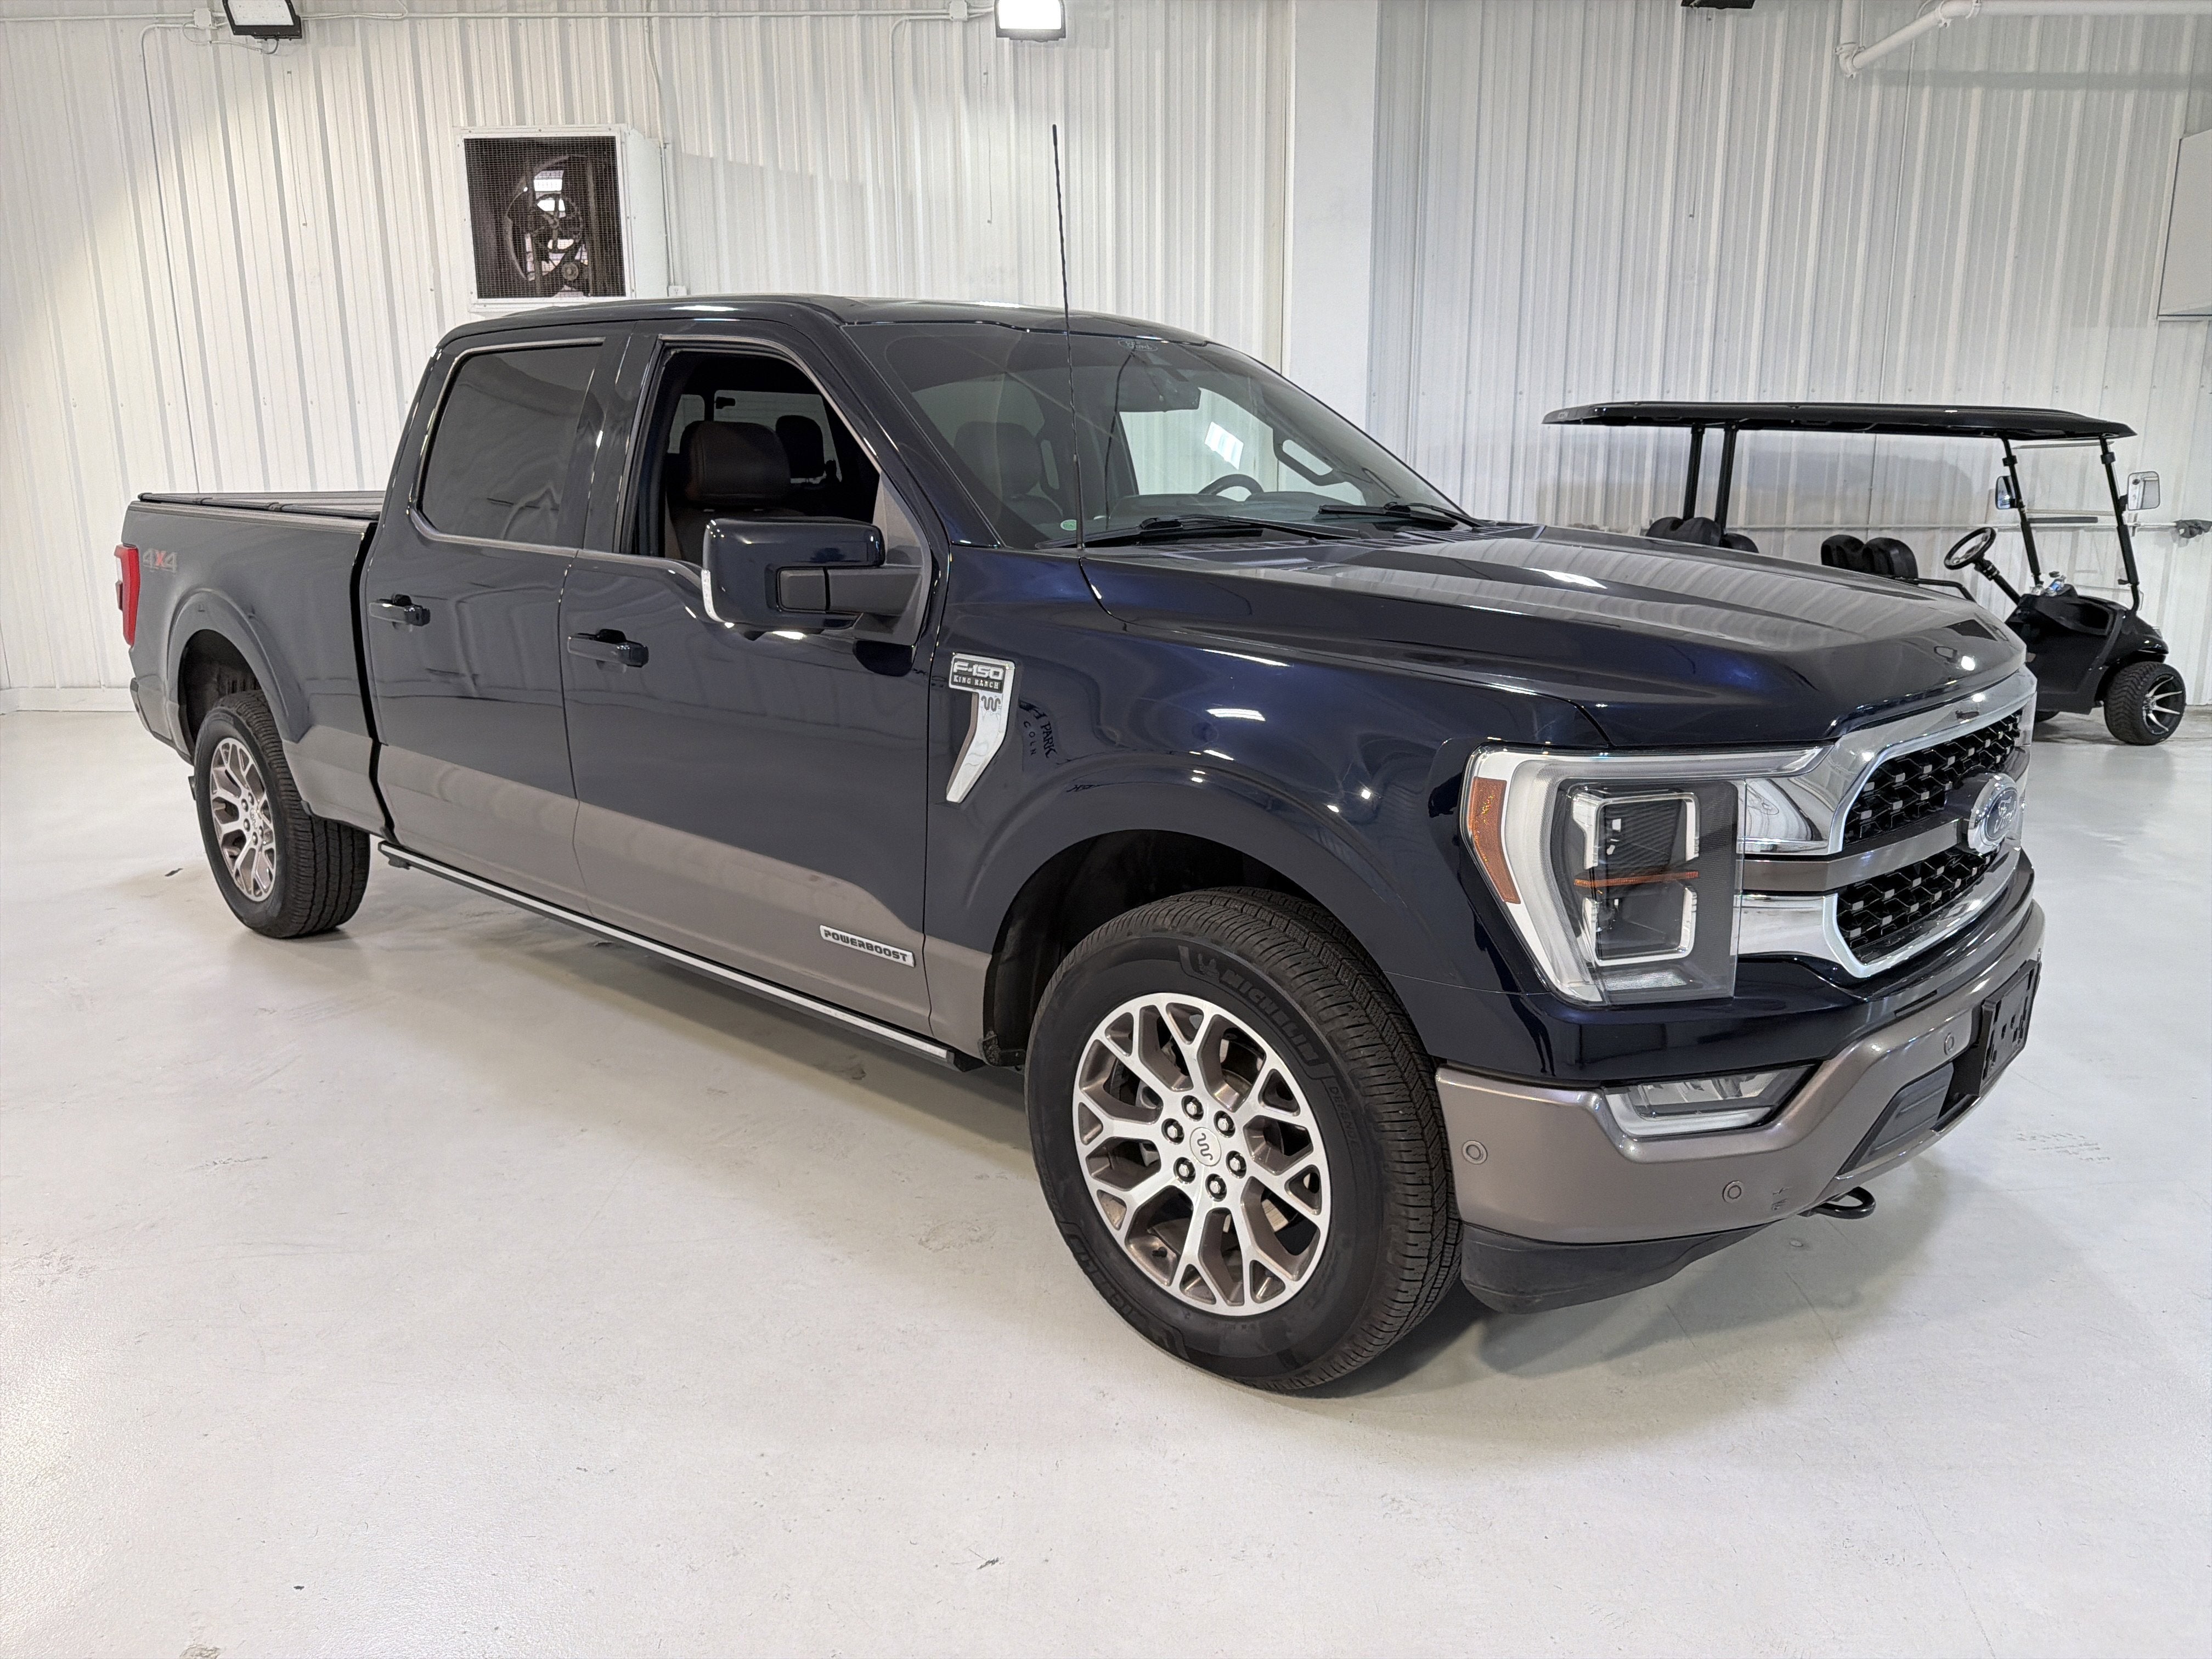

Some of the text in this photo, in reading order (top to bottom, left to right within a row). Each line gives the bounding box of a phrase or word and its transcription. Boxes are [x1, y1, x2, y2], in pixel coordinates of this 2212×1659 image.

[953, 661, 1005, 680] F-150
[953, 675, 998, 690] KING RANCH
[823, 928, 908, 962] POWERBOOST
[1219, 969, 1319, 1062] MICHELIN
[1328, 1086, 1360, 1149] DEFENDE
